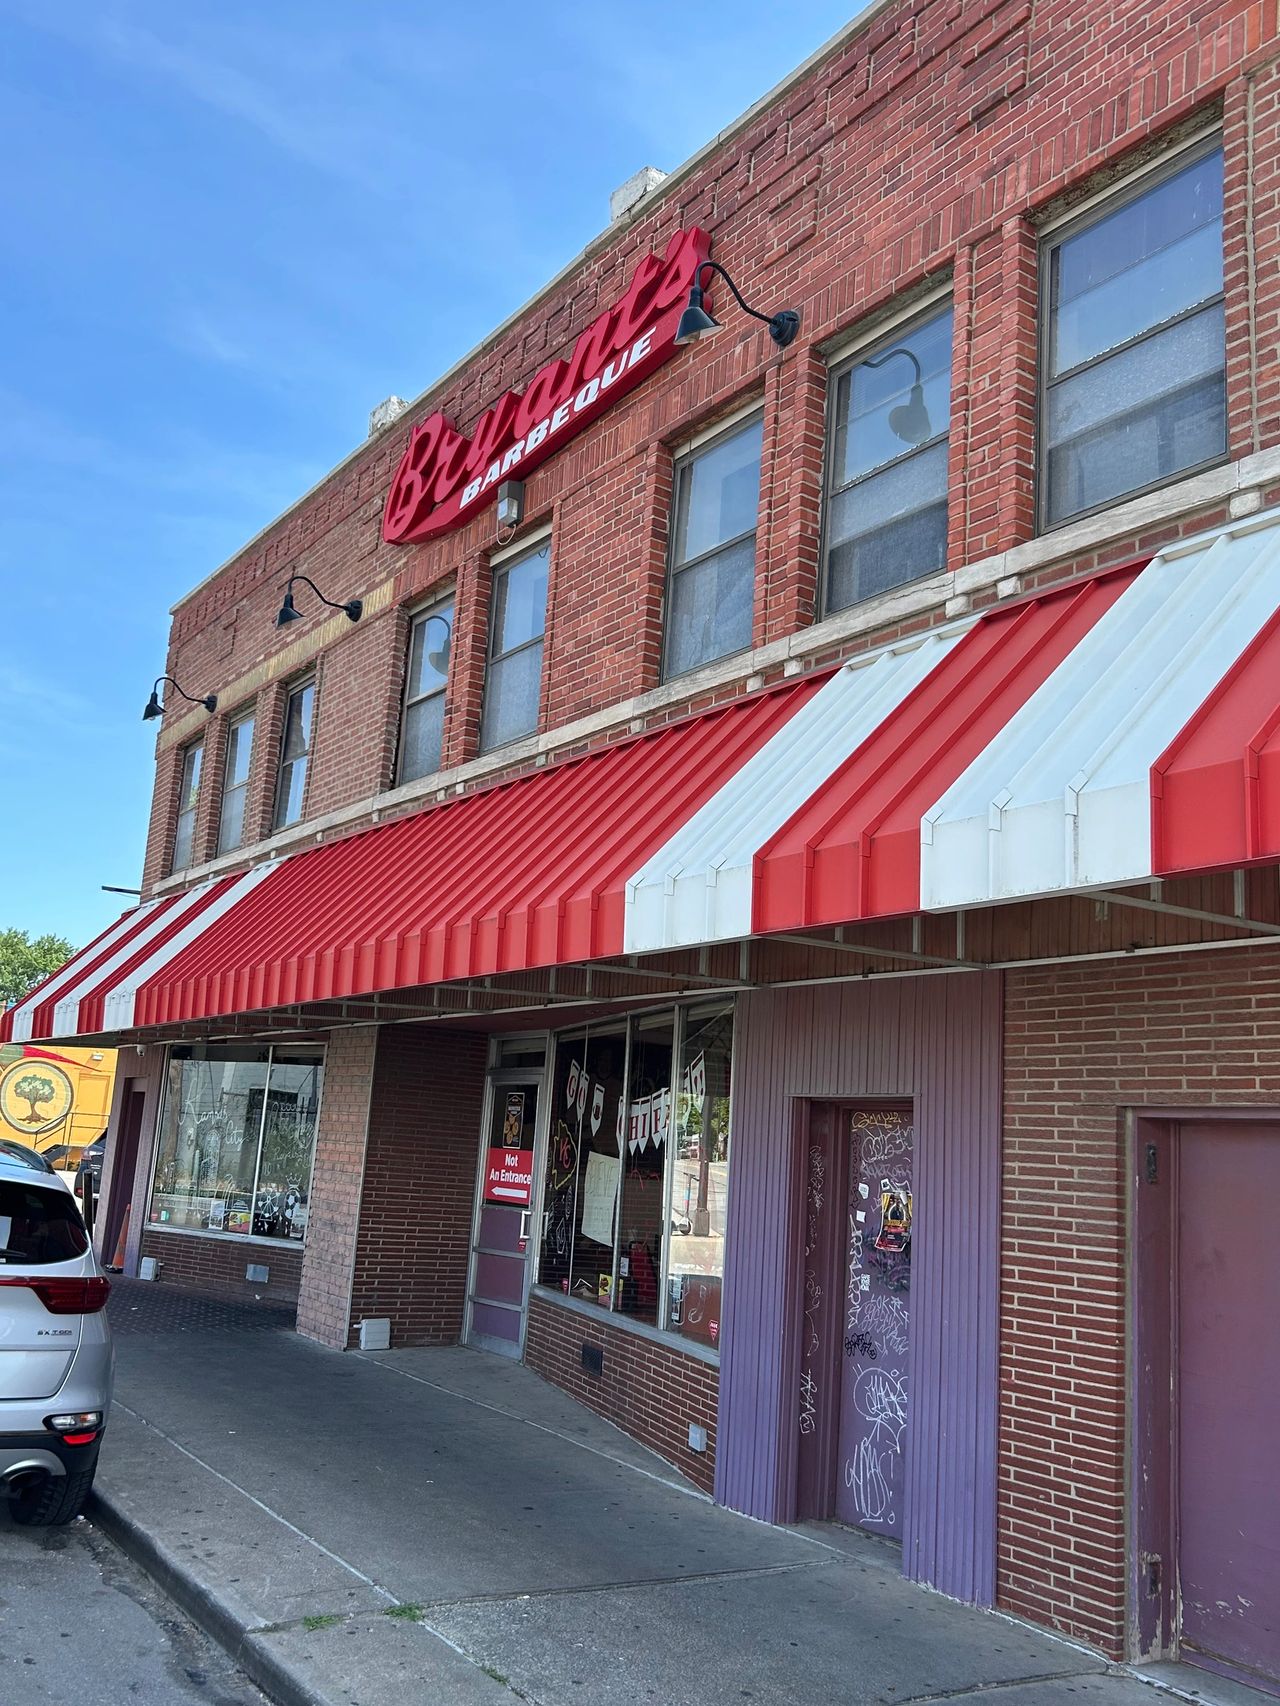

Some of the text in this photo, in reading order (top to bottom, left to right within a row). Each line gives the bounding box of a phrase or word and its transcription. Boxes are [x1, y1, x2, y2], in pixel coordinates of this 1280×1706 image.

[384, 227, 712, 543] Bryant's
[458, 326, 658, 510] BARBEQUE
[489, 1168, 532, 1185] An Entrance
[505, 1153, 518, 1167] Not
